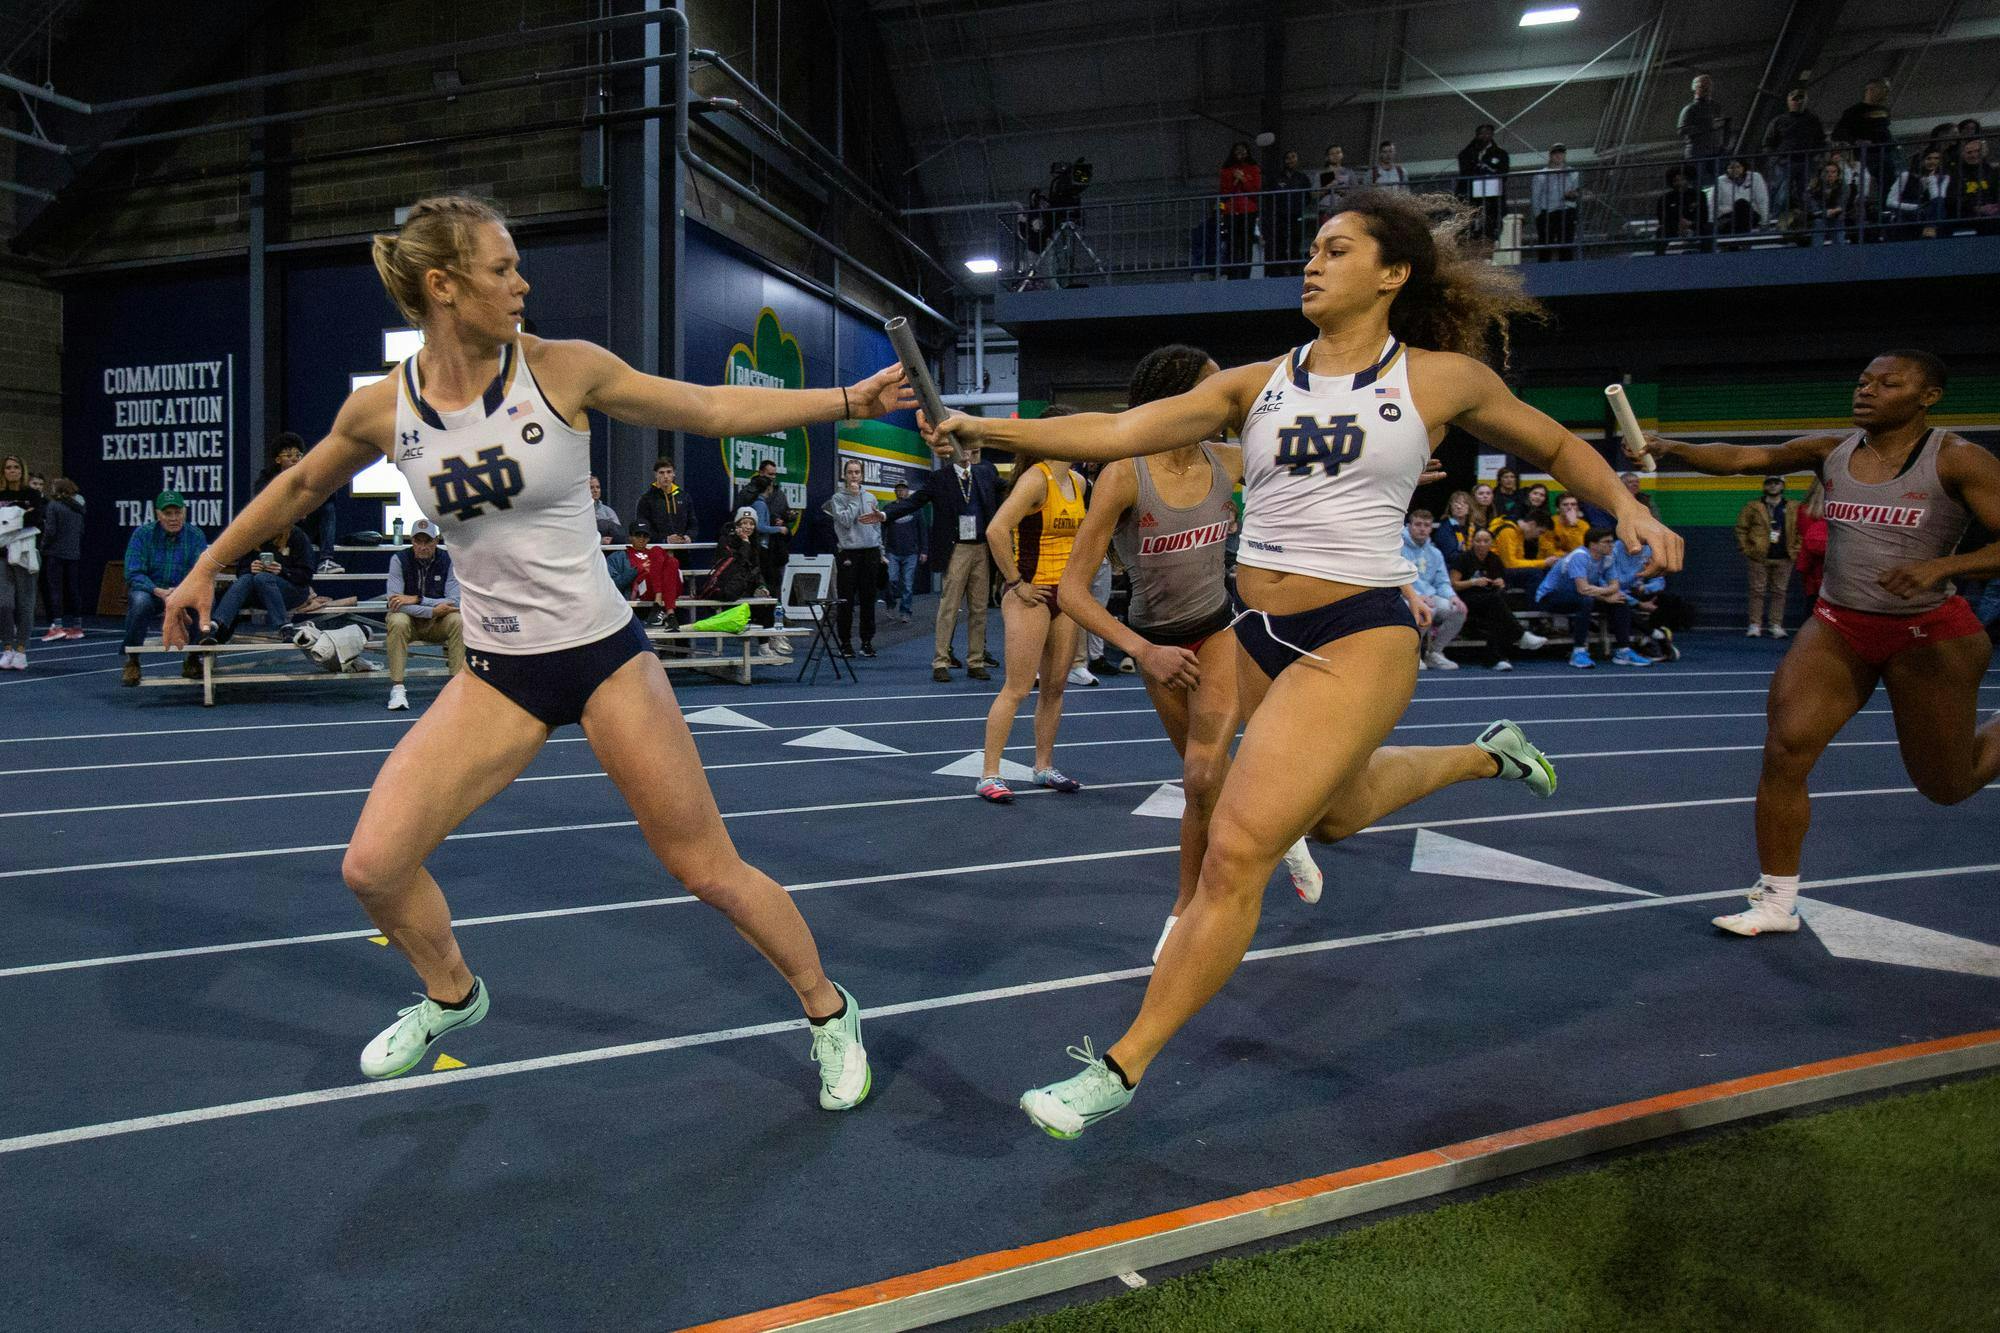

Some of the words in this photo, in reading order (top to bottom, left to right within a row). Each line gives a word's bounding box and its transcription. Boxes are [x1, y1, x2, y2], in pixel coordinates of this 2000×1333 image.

[103, 361, 223, 395] COMMUNITY
[114, 396, 223, 428] EDUCATION
[1257, 403, 1284, 412] ACC
[1382, 407, 1398, 417] AB
[101, 430, 224, 461] EXCELLENCE
[402, 446, 424, 458] ACC
[162, 464, 224, 493] FAITH
[115, 499, 223, 527] TRAION
[1139, 521, 1230, 556] LOUISVILL
